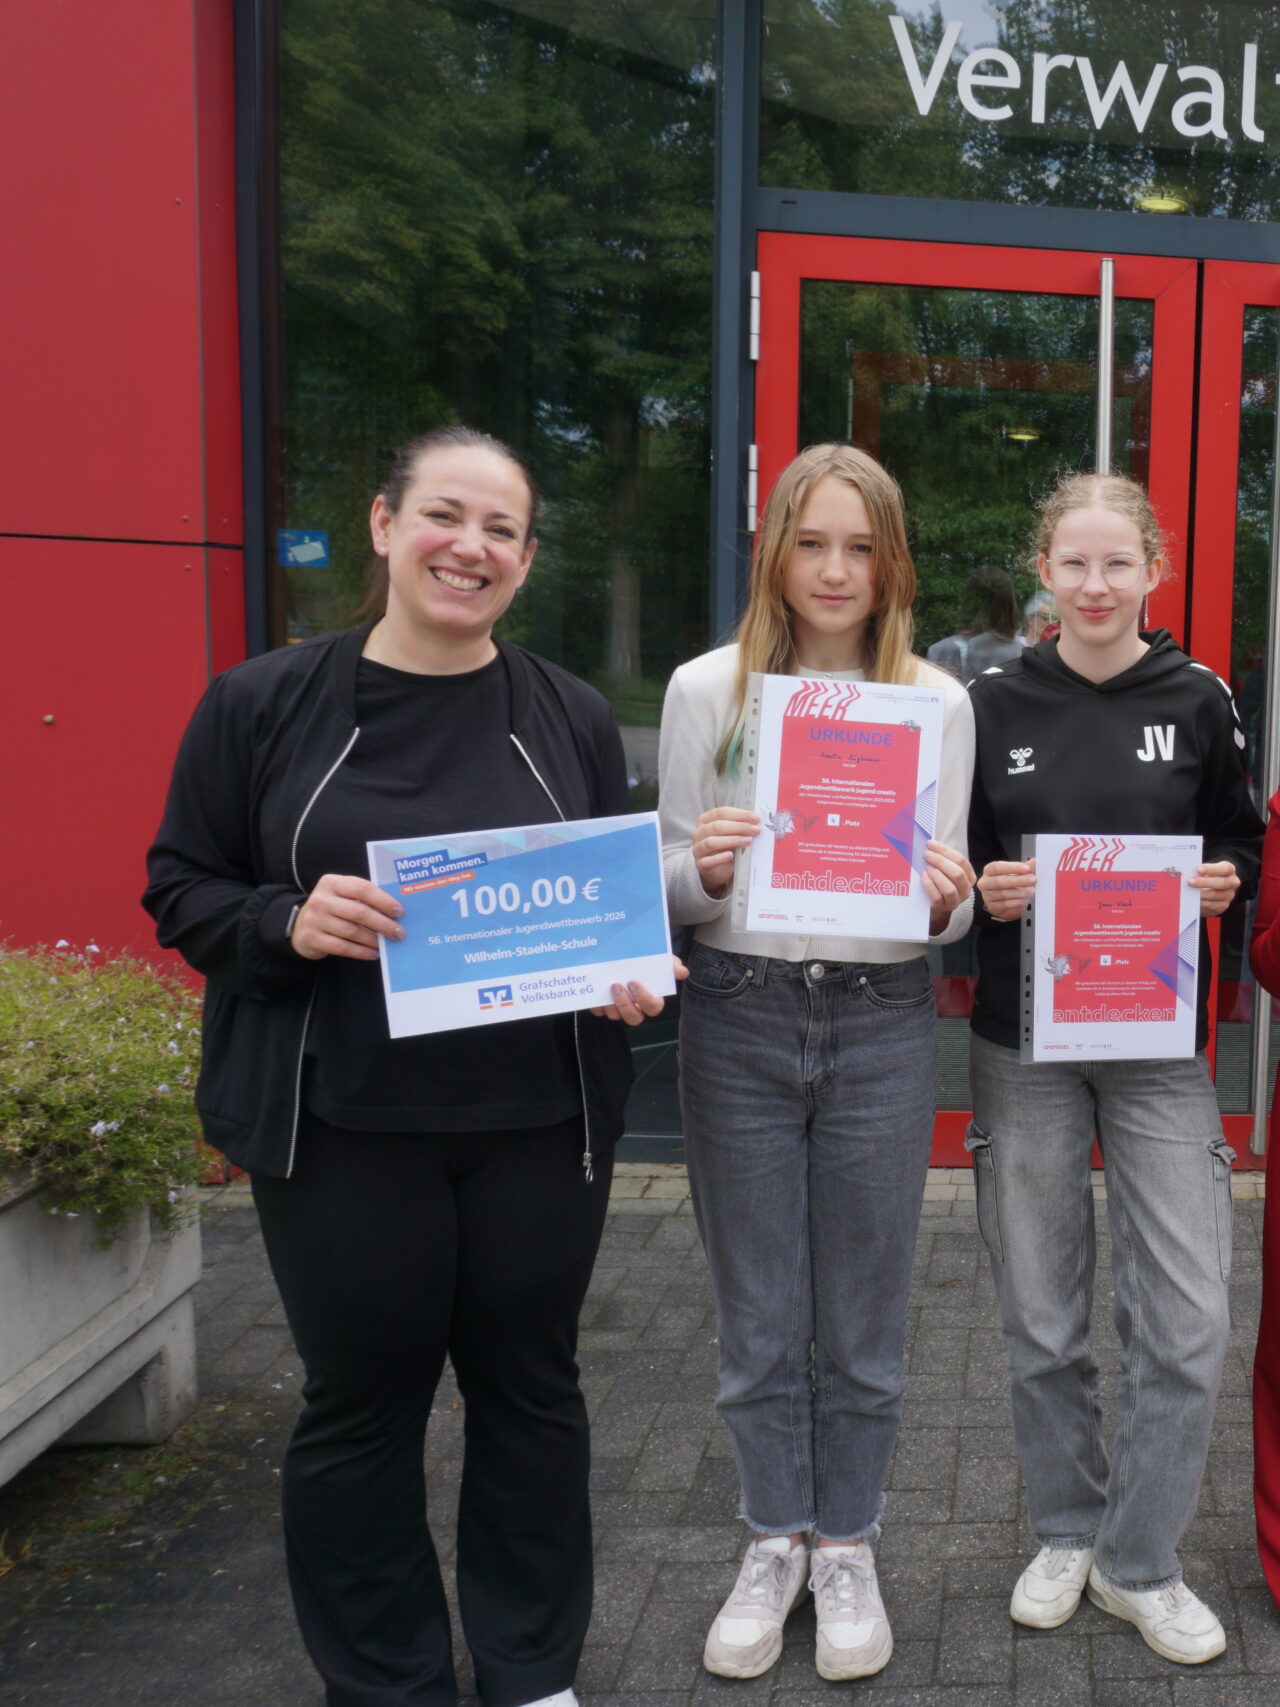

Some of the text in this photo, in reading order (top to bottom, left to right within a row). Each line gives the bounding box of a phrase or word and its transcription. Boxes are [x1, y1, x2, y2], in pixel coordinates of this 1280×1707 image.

[810, 727, 893, 746] URKUNDE
[1136, 724, 1175, 762] JV
[1008, 763, 1035, 775] hummel
[396, 853, 444, 872] Morgen
[399, 857, 485, 883] kann kommen.
[771, 870, 910, 896] entdecken
[1081, 879, 1157, 892] URKUNDE
[451, 875, 602, 918] 100,00 €
[428, 910, 626, 946] 56. Internationaler Jugendwettbewerb 2026
[464, 936, 597, 965] Wilhelm-Staehle-Schule
[519, 974, 587, 992] Grafschafter
[521, 983, 594, 1004] Volksbank eG
[1053, 1003, 1177, 1023] entdecken
